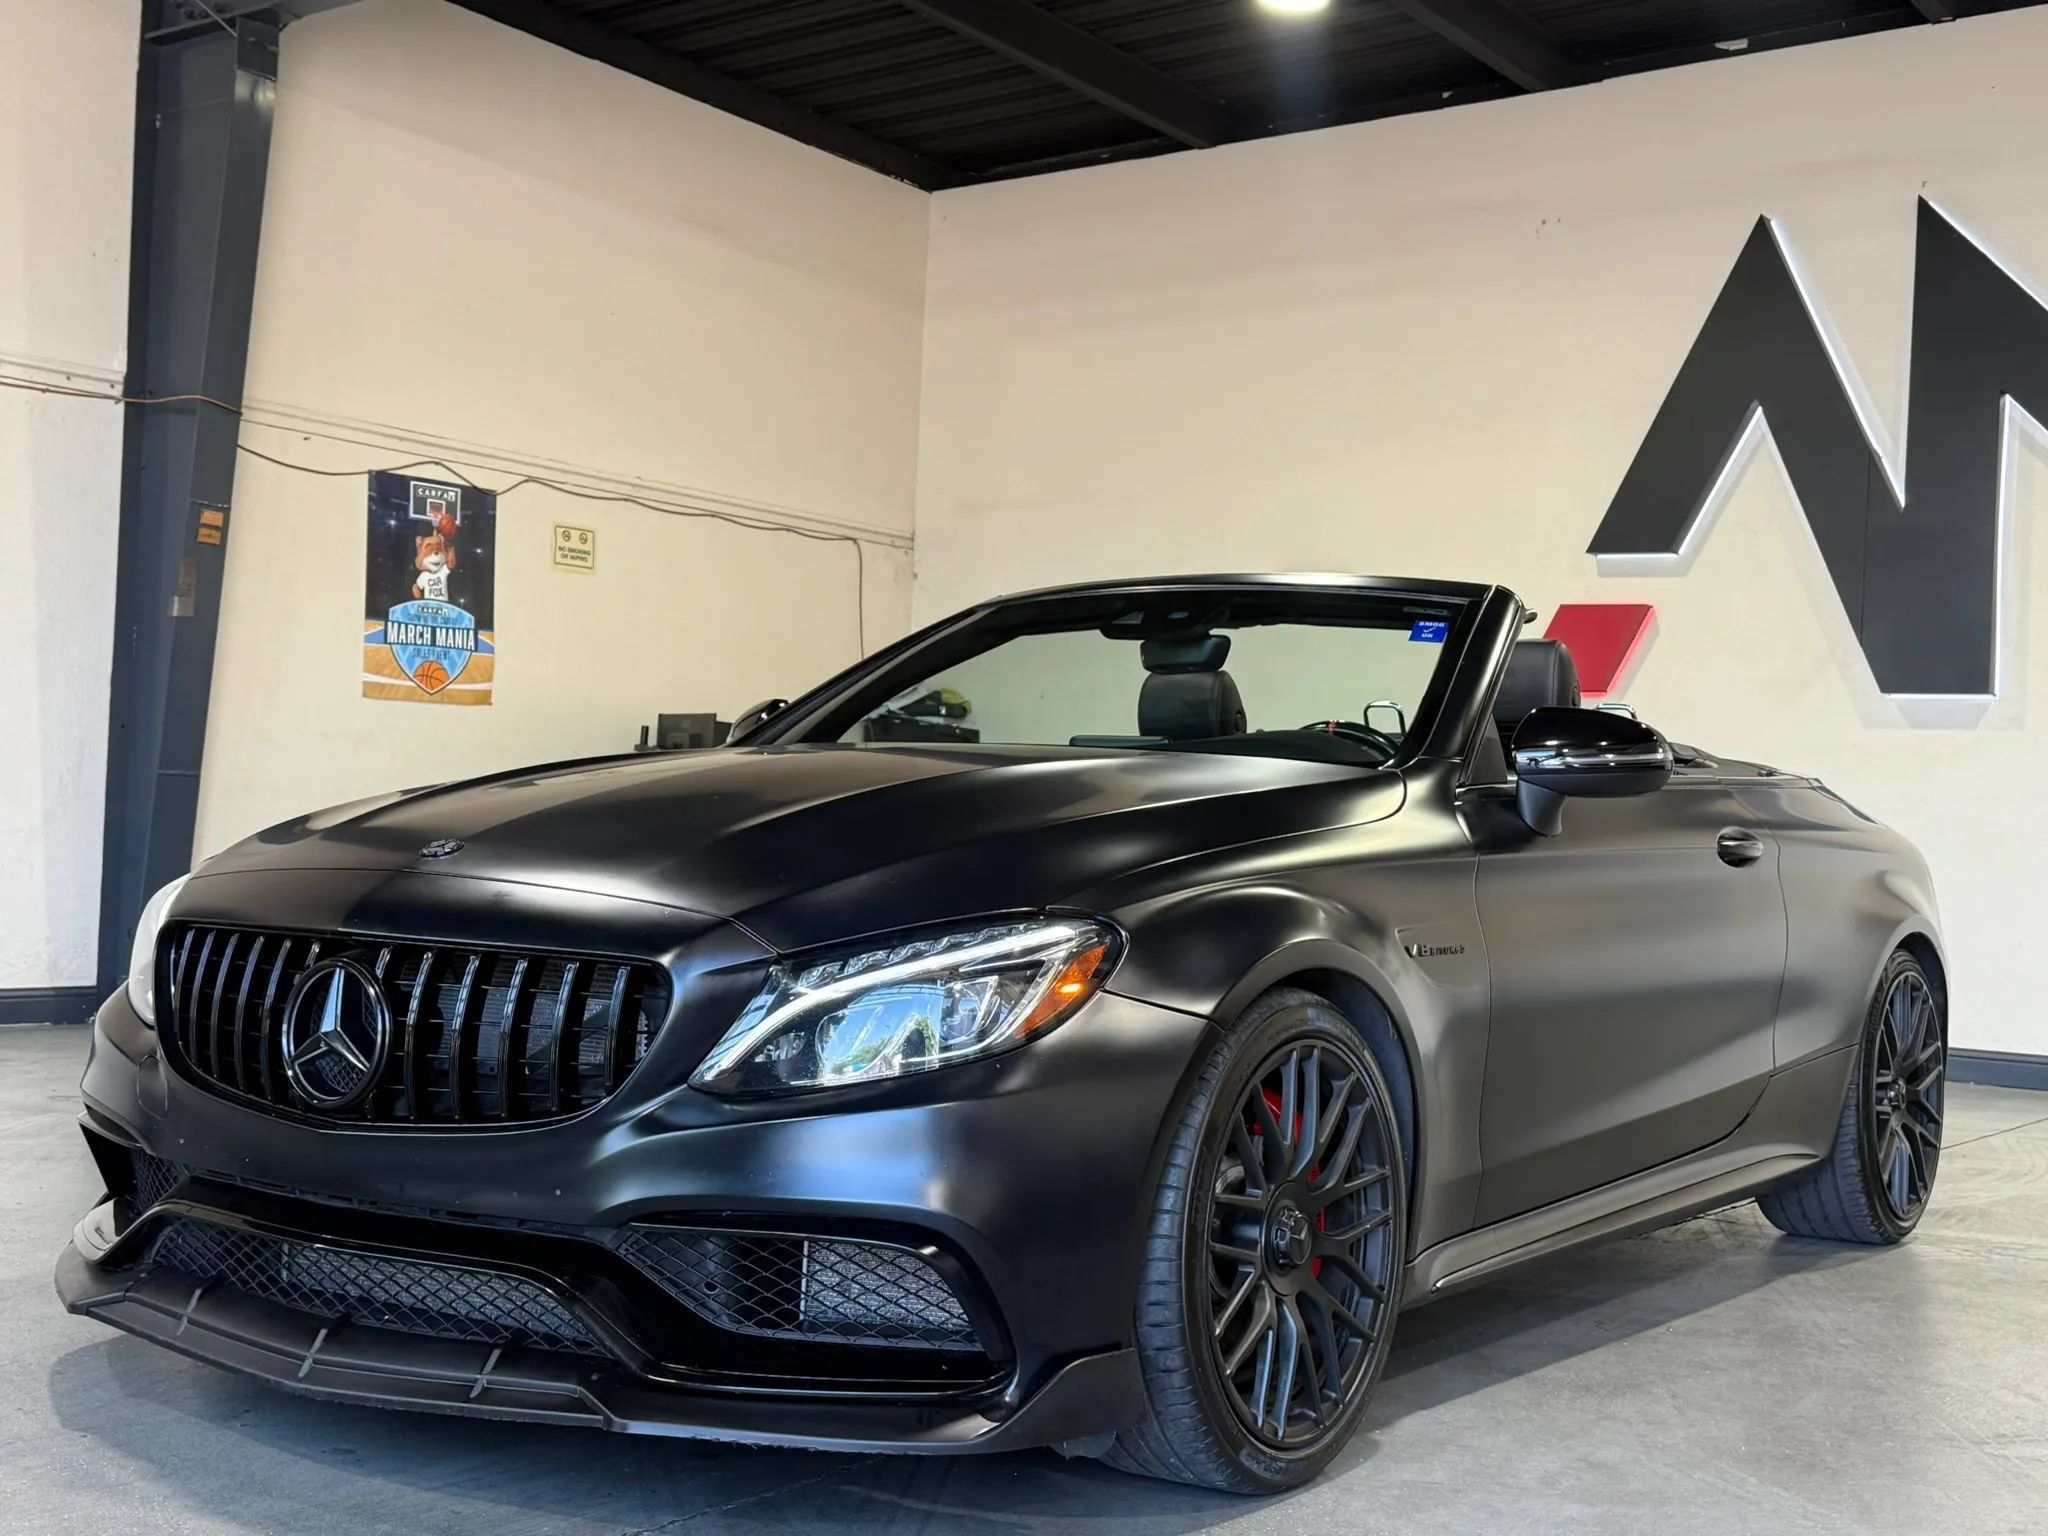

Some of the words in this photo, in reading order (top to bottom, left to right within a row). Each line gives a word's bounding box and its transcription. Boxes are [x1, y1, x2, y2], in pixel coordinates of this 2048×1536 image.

[427, 577, 442, 587] CAR
[428, 588, 444, 598] FOX
[387, 621, 431, 645] MARCH
[435, 627, 475, 651] MANIA
